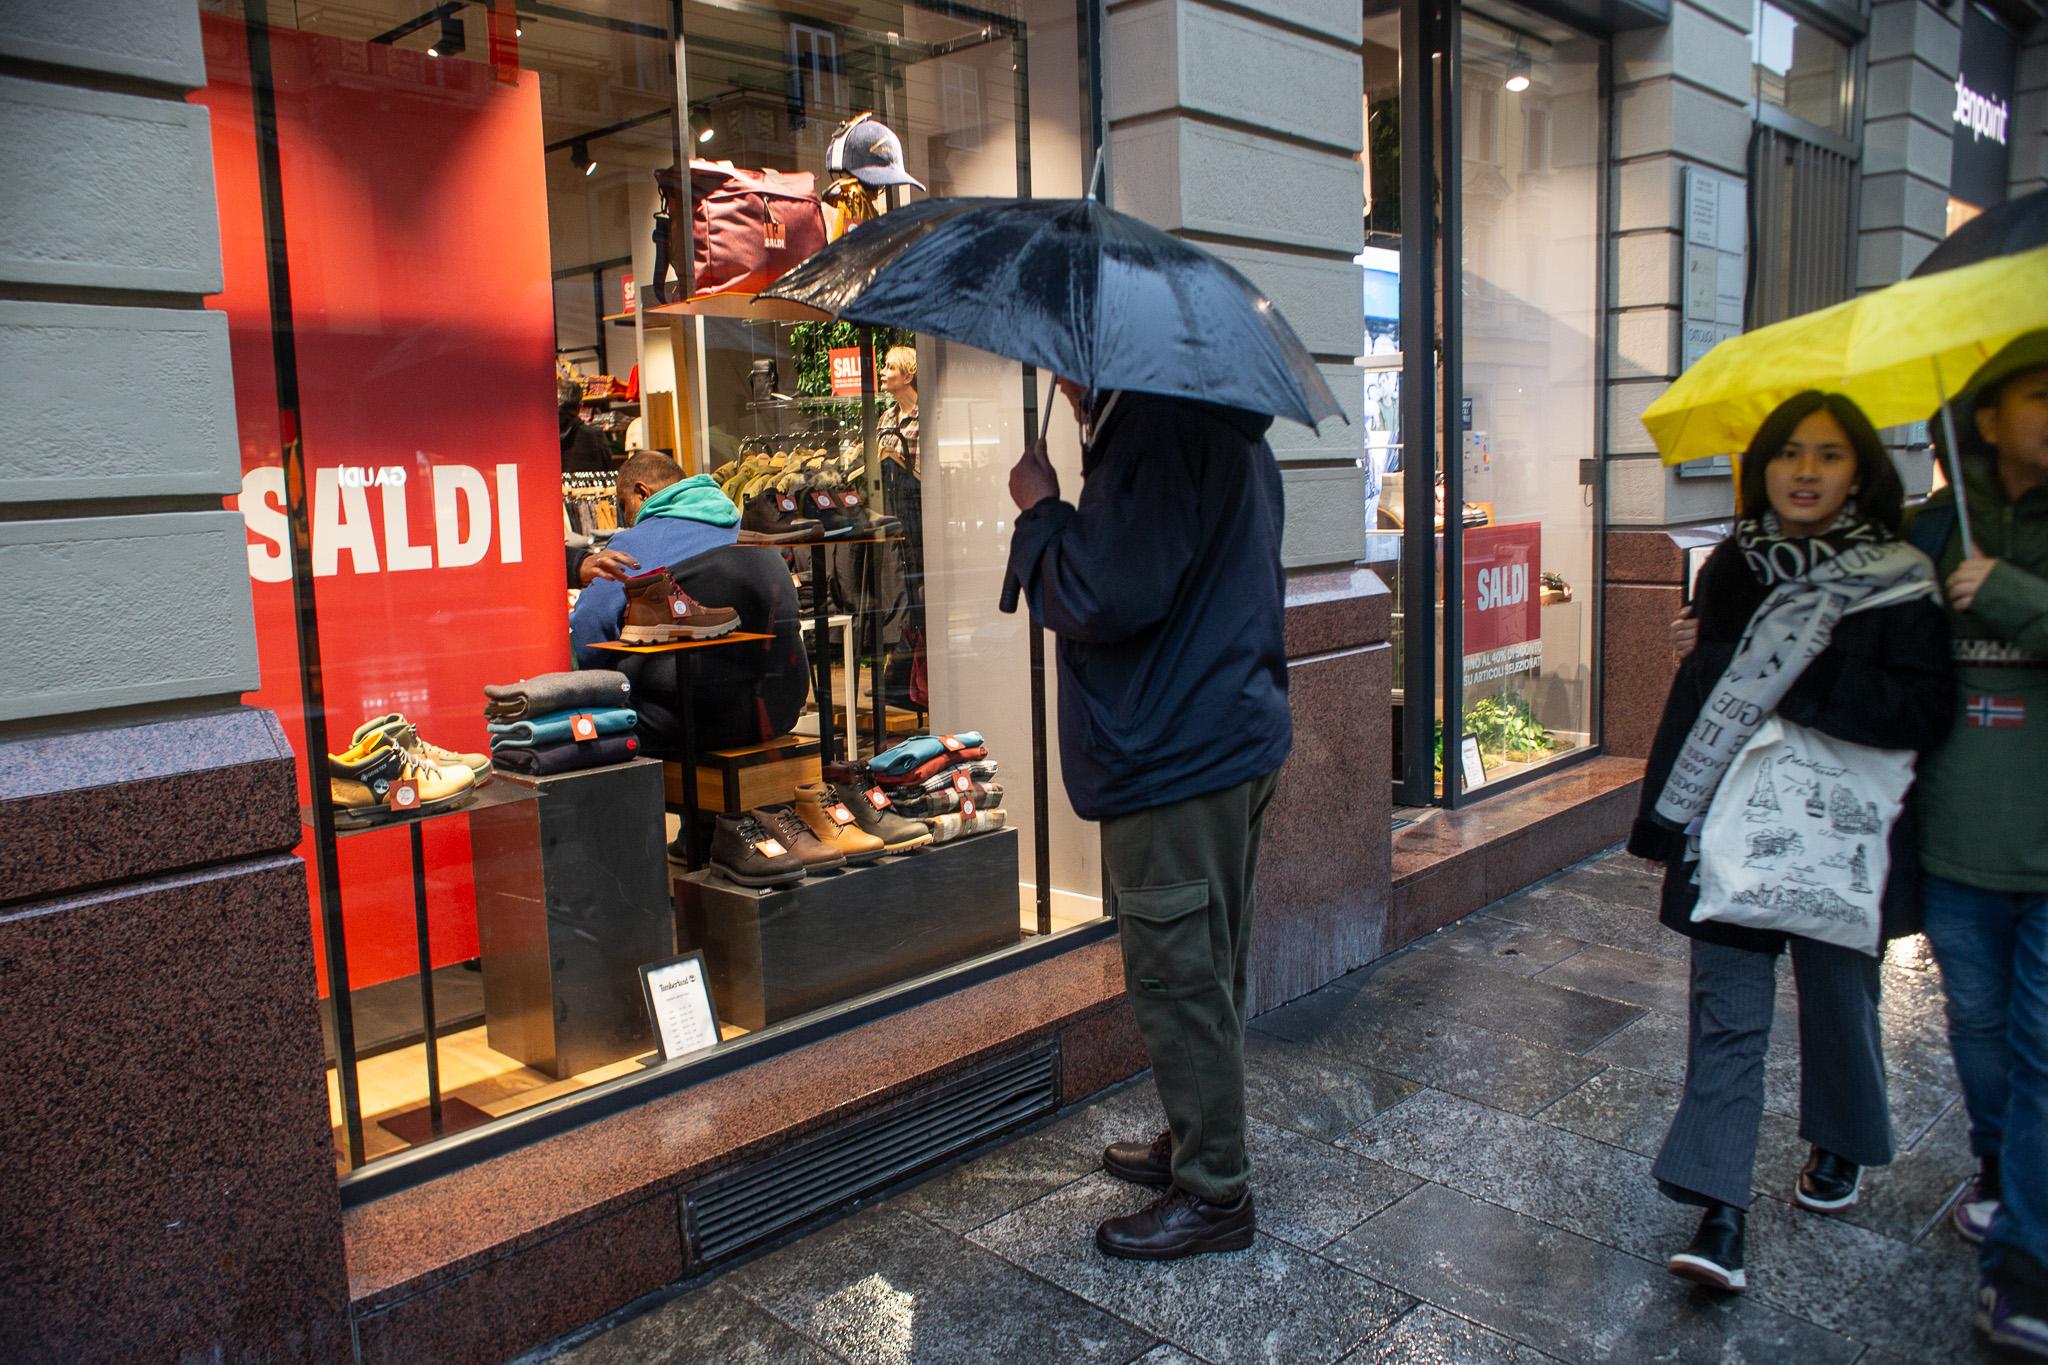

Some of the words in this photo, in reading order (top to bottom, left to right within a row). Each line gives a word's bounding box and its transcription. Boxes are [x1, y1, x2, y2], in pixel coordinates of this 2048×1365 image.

[238, 464, 522, 583] SALDI
[1477, 562, 1529, 612] SALDI
[1474, 665, 1504, 683] ARTICOLI
